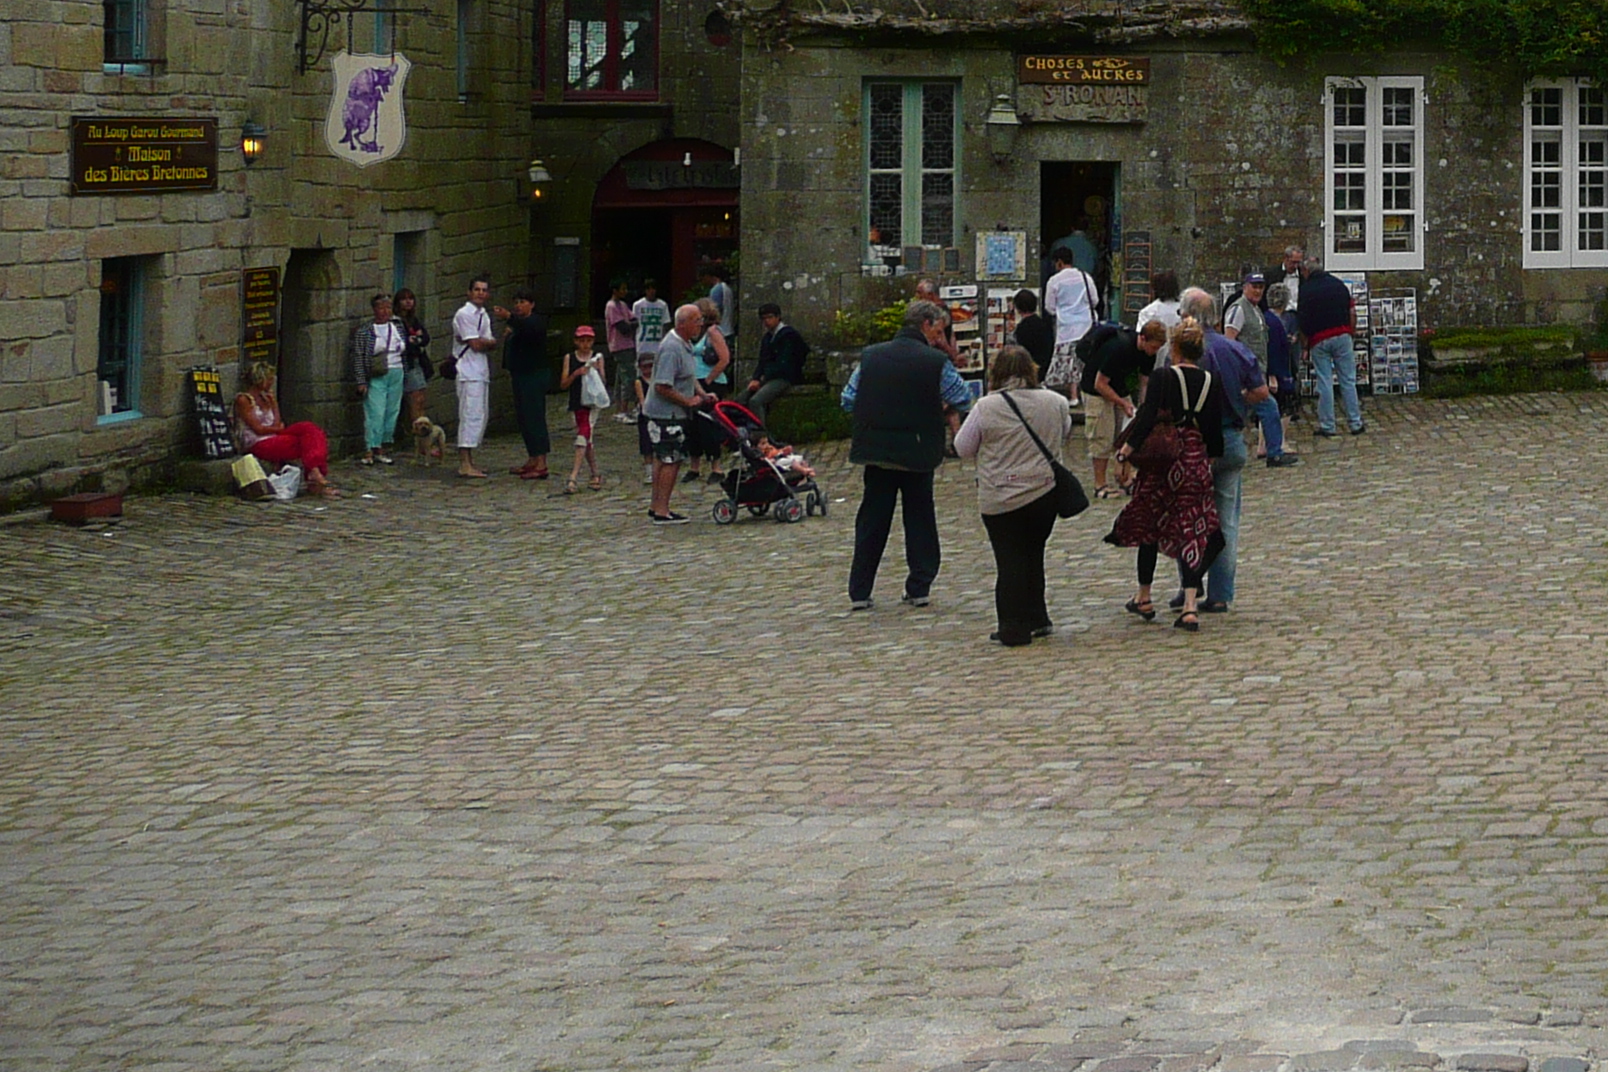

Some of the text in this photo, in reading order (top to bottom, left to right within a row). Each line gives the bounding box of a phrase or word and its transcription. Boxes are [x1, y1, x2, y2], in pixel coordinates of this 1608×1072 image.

[1025, 57, 1084, 69] CHOSES
[1081, 69, 1144, 81] AUTRES
[1064, 85, 1143, 106] RONAN
[88, 125, 205, 141] Au Loup Garou Gourmand
[128, 146, 171, 162] Maison
[84, 164, 208, 182] des Bières Bretonnes
